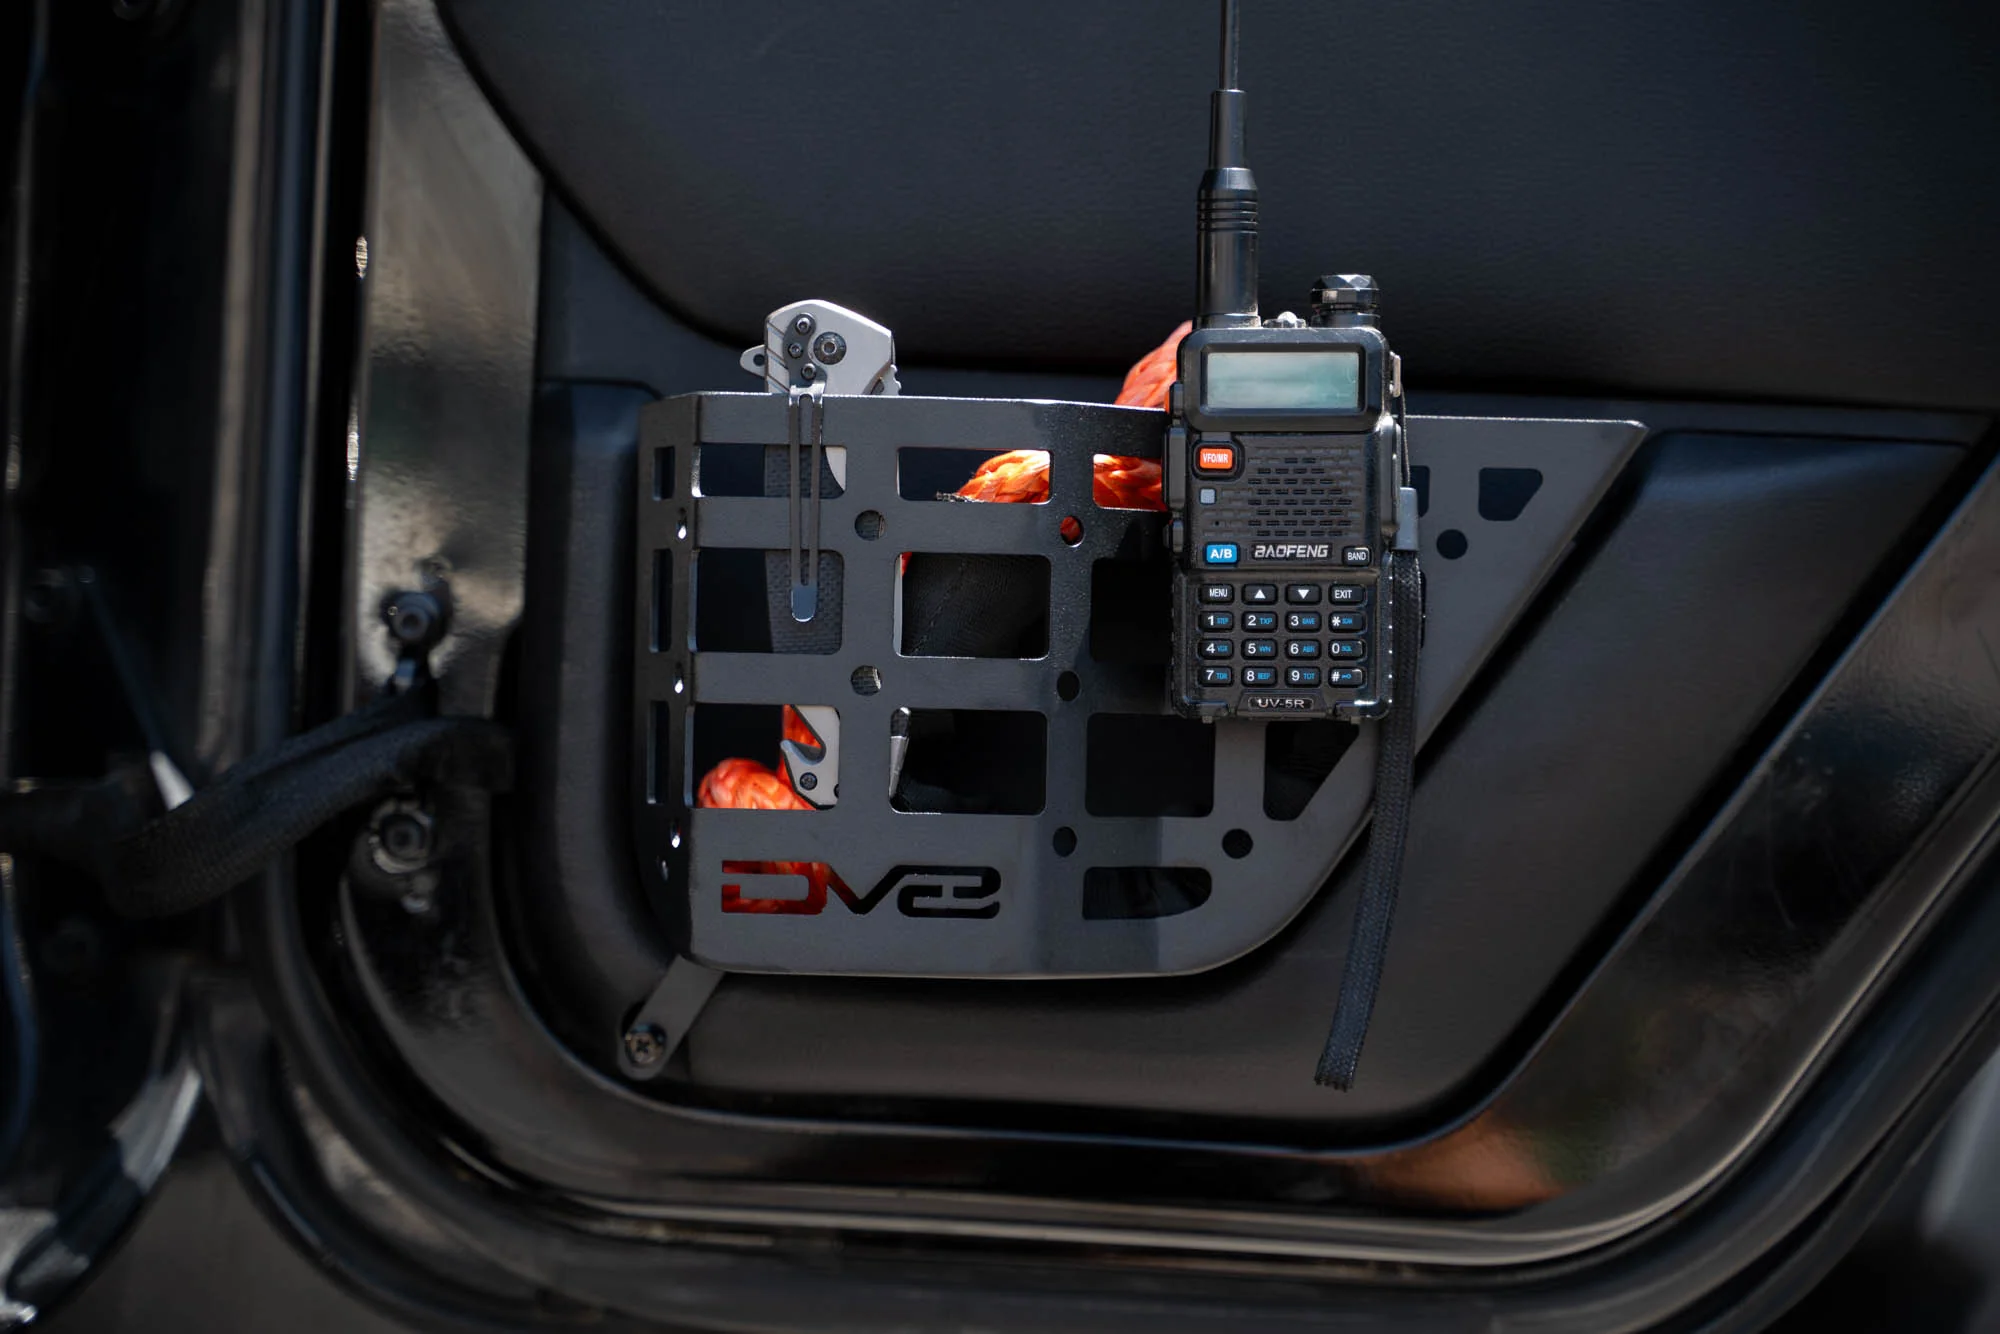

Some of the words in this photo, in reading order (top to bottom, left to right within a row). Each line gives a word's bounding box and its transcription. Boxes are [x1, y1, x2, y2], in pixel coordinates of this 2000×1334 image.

[1210, 548, 1233, 559] A/B
[1254, 544, 1329, 558] BAOFENG
[1347, 551, 1367, 561] BAND
[1209, 588, 1228, 597] MENU
[1334, 589, 1353, 599] EXIT
[1207, 615, 1214, 626] 1
[1247, 615, 1257, 626] 2
[1290, 615, 1299, 626] 3
[1206, 642, 1216, 654] 4
[1247, 642, 1257, 655] 5
[1290, 643, 1299, 654] 6
[1206, 669, 1215, 681] 7
[1246, 670, 1255, 682] 8
[1291, 670, 1300, 681] 9
[1258, 698, 1305, 709] UV-5R
